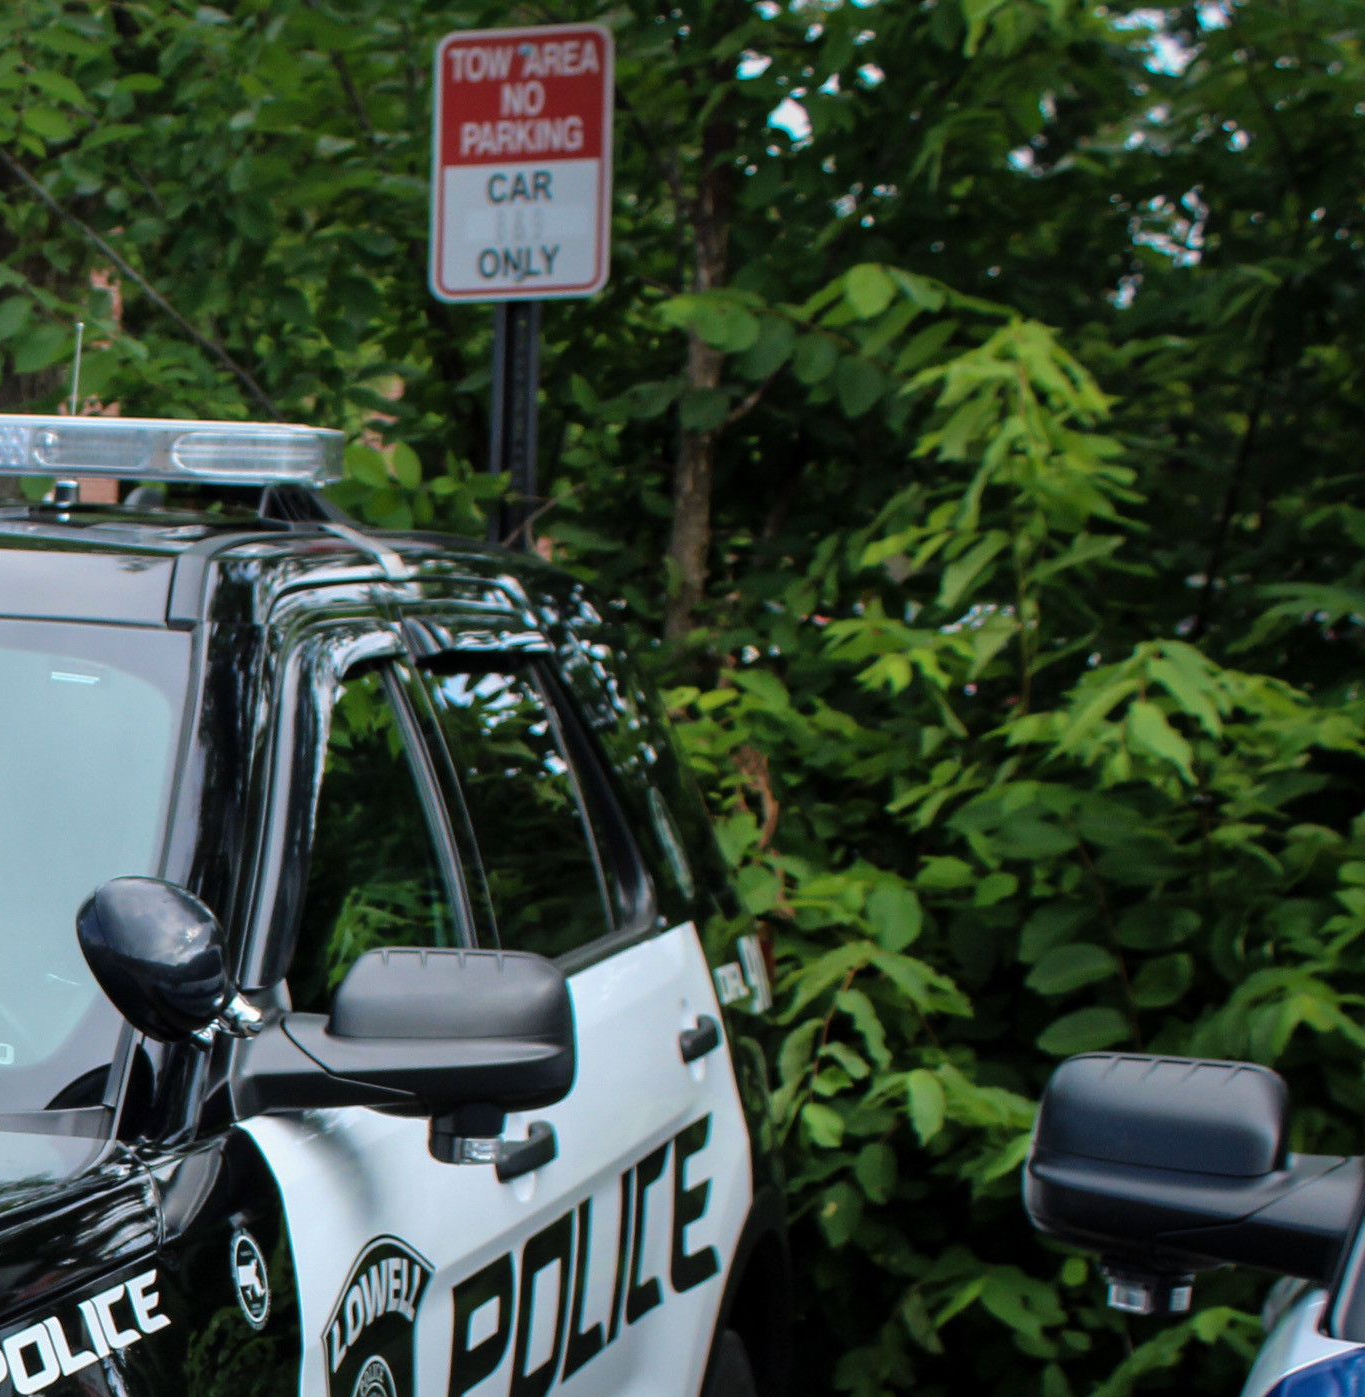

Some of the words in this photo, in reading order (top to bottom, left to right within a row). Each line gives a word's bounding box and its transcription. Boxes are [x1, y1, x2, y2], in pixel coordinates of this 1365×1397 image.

[449, 46, 513, 82] TOW
[521, 40, 599, 78] AREA
[500, 80, 545, 117] NO
[460, 115, 584, 156] PARKING
[487, 170, 553, 204] CAR
[479, 245, 560, 278] ONLY
[331, 1257, 422, 1374] LOWELL
